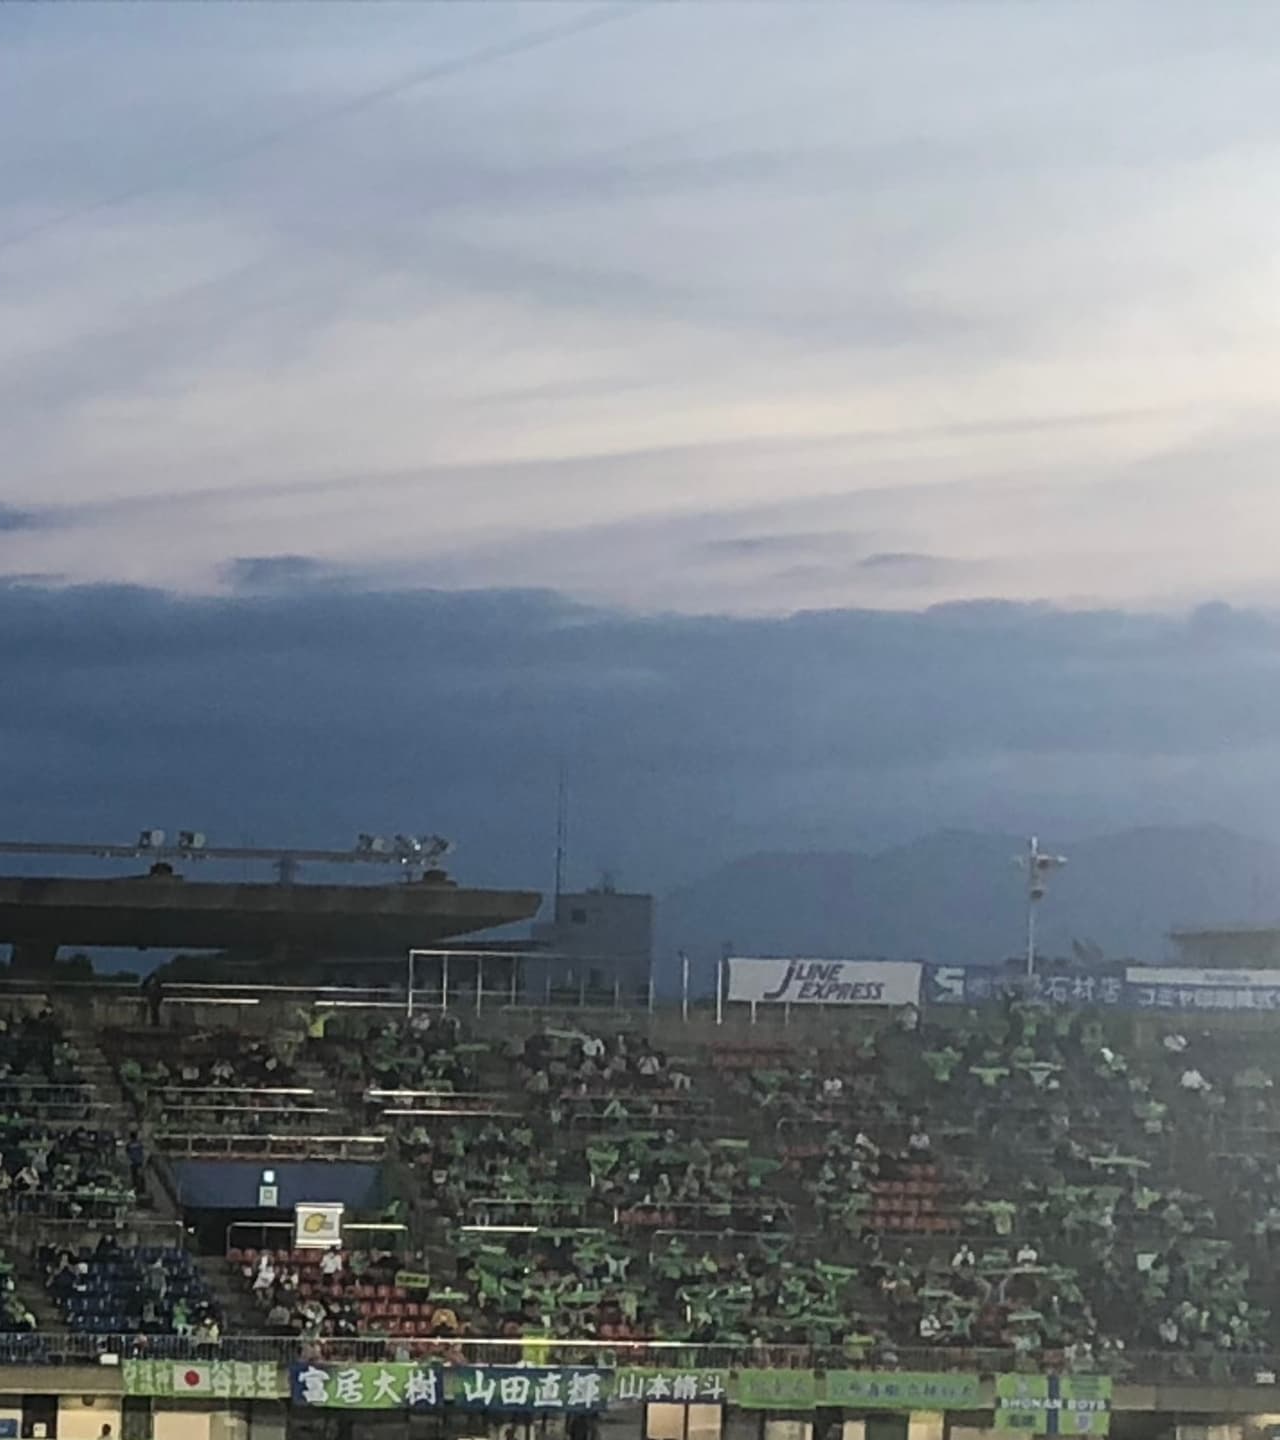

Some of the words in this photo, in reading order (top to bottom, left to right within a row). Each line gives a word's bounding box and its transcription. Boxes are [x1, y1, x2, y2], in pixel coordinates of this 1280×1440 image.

[794, 964, 844, 981] LINE
[797, 982, 885, 1000] EXPRESS
[298, 1366, 438, 1406] 富居大樹
[464, 1369, 603, 1409] 山田直輝
